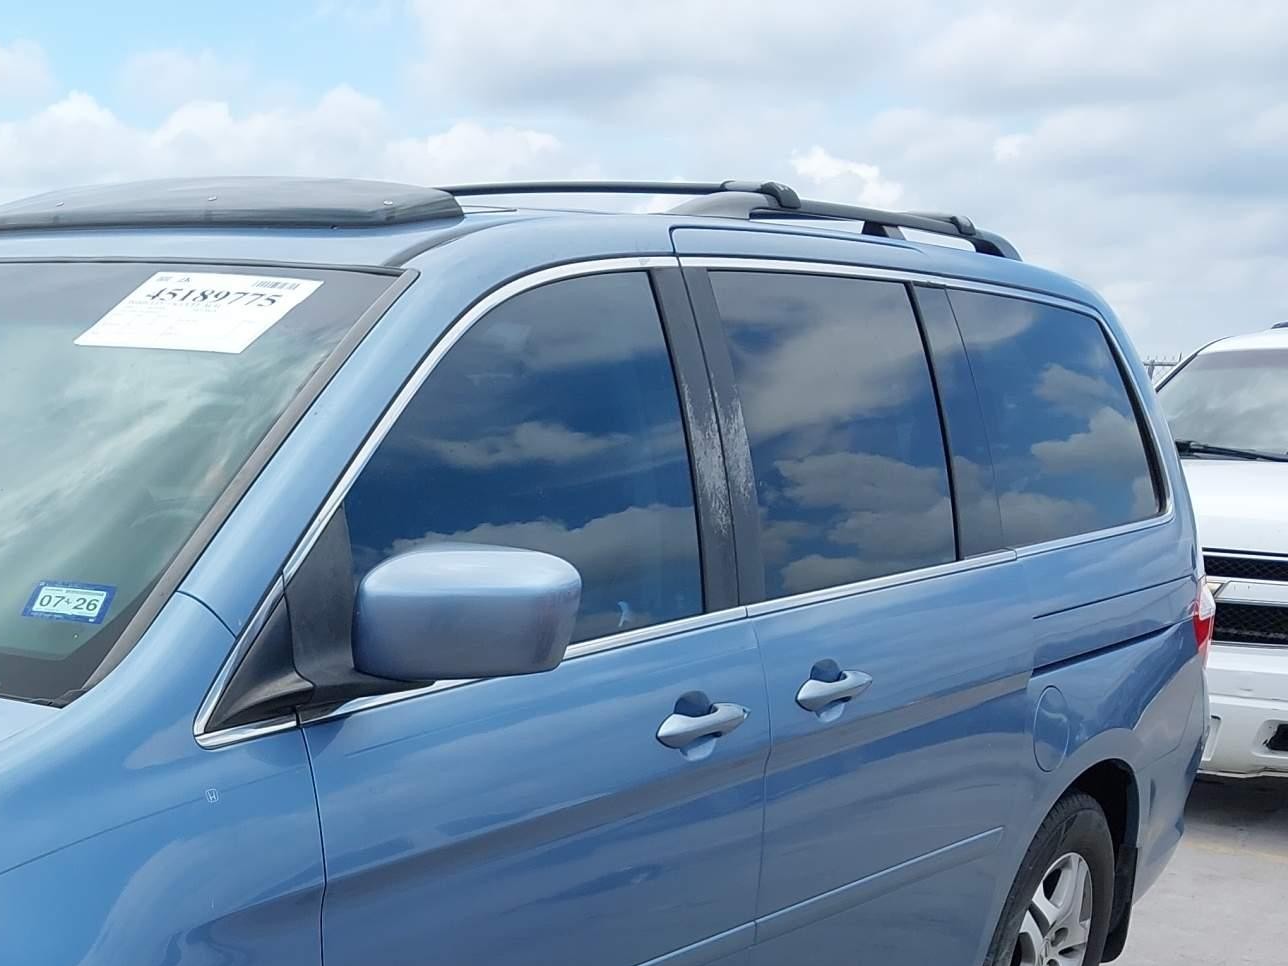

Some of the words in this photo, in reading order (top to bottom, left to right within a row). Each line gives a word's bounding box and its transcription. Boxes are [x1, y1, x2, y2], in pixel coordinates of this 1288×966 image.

[146, 288, 283, 307] 45189775
[40, 594, 65, 608] 07
[72, 598, 99, 611] 26
